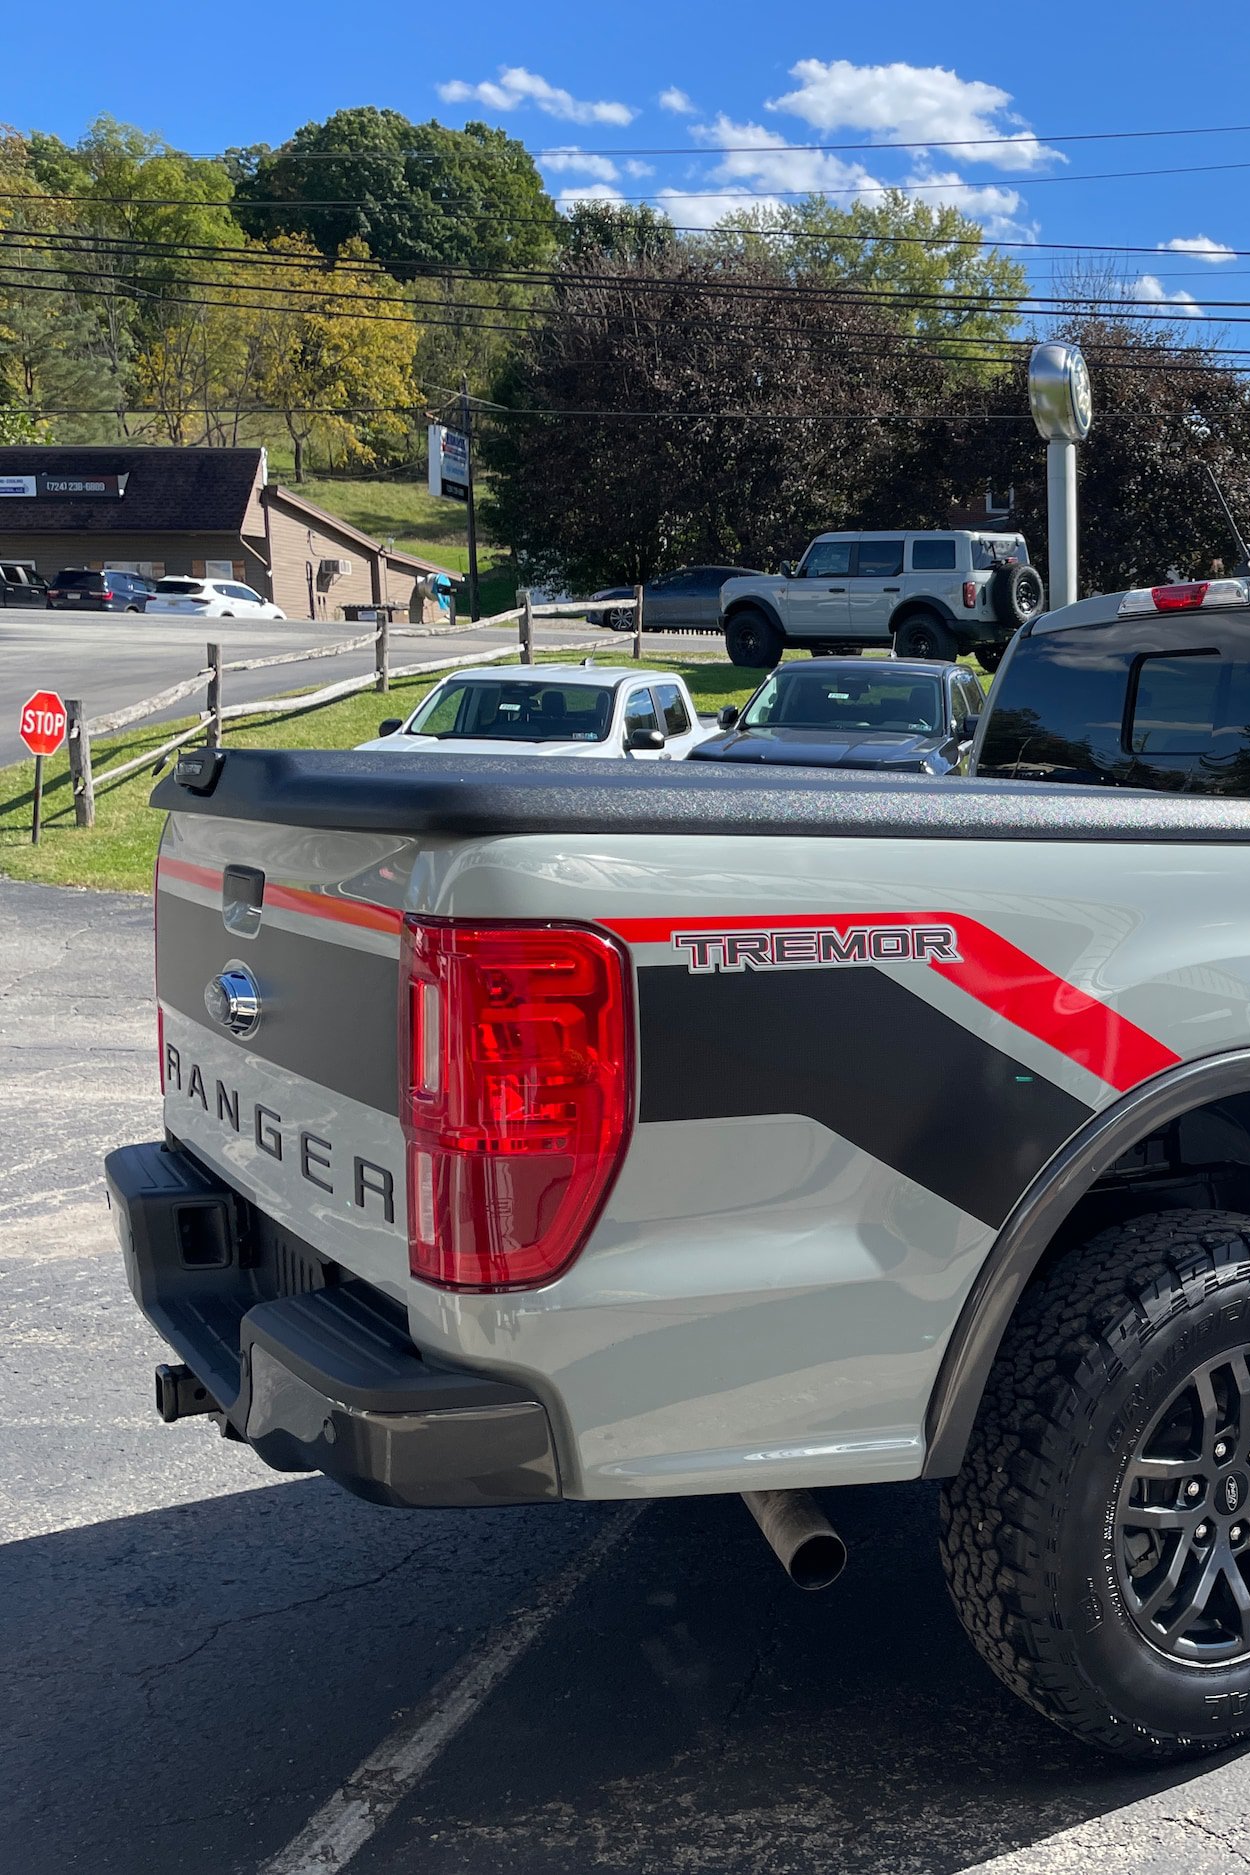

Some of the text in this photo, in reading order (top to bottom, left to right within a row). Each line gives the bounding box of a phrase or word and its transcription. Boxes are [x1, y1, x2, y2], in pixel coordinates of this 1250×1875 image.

[46, 481, 67, 492] (724)
[23, 709, 65, 736] STOP
[673, 926, 962, 971] TREMOR
[166, 1042, 395, 1224] RANGER
